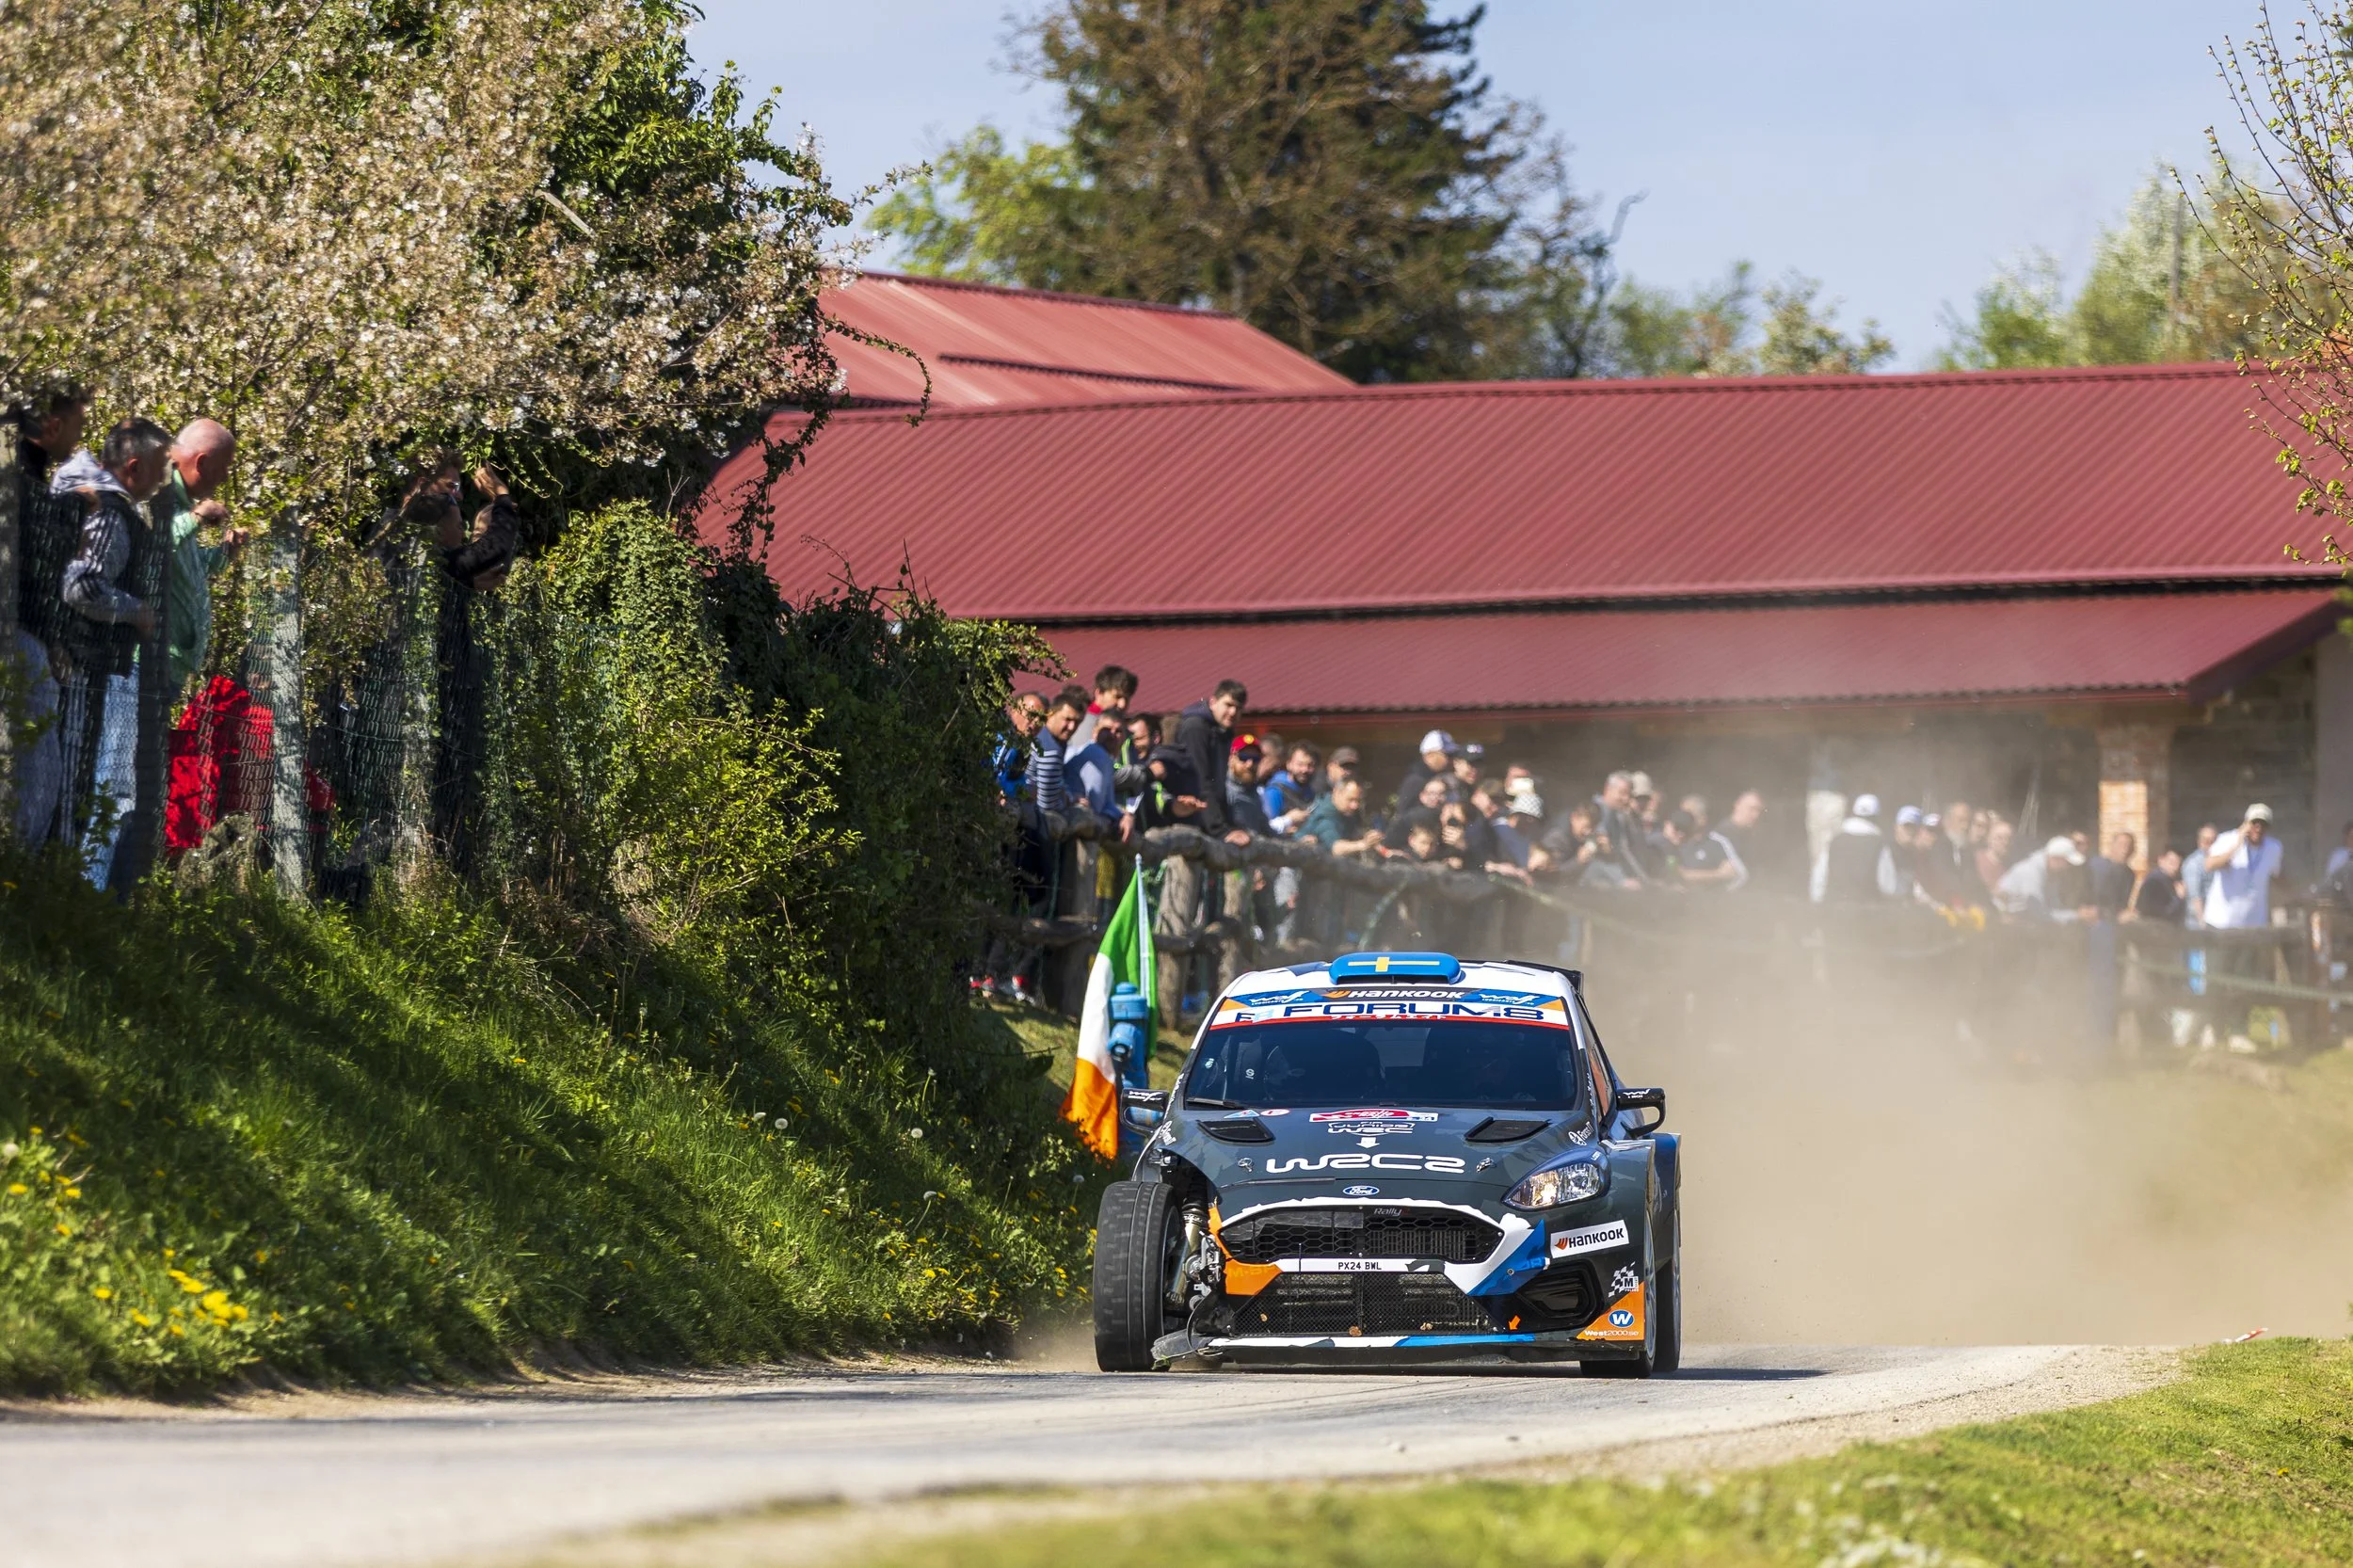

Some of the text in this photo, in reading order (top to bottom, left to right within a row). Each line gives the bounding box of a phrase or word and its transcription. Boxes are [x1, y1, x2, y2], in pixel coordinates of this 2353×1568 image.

[1348, 990, 1465, 999] HANKOOK
[1284, 1003, 1544, 1020] FORUM8
[1267, 1154, 1465, 1174] WRC2
[1569, 1228, 1625, 1249] HANKOOK
[1337, 1262, 1382, 1271] PX24 BWL
[1612, 1313, 1632, 1325] W
